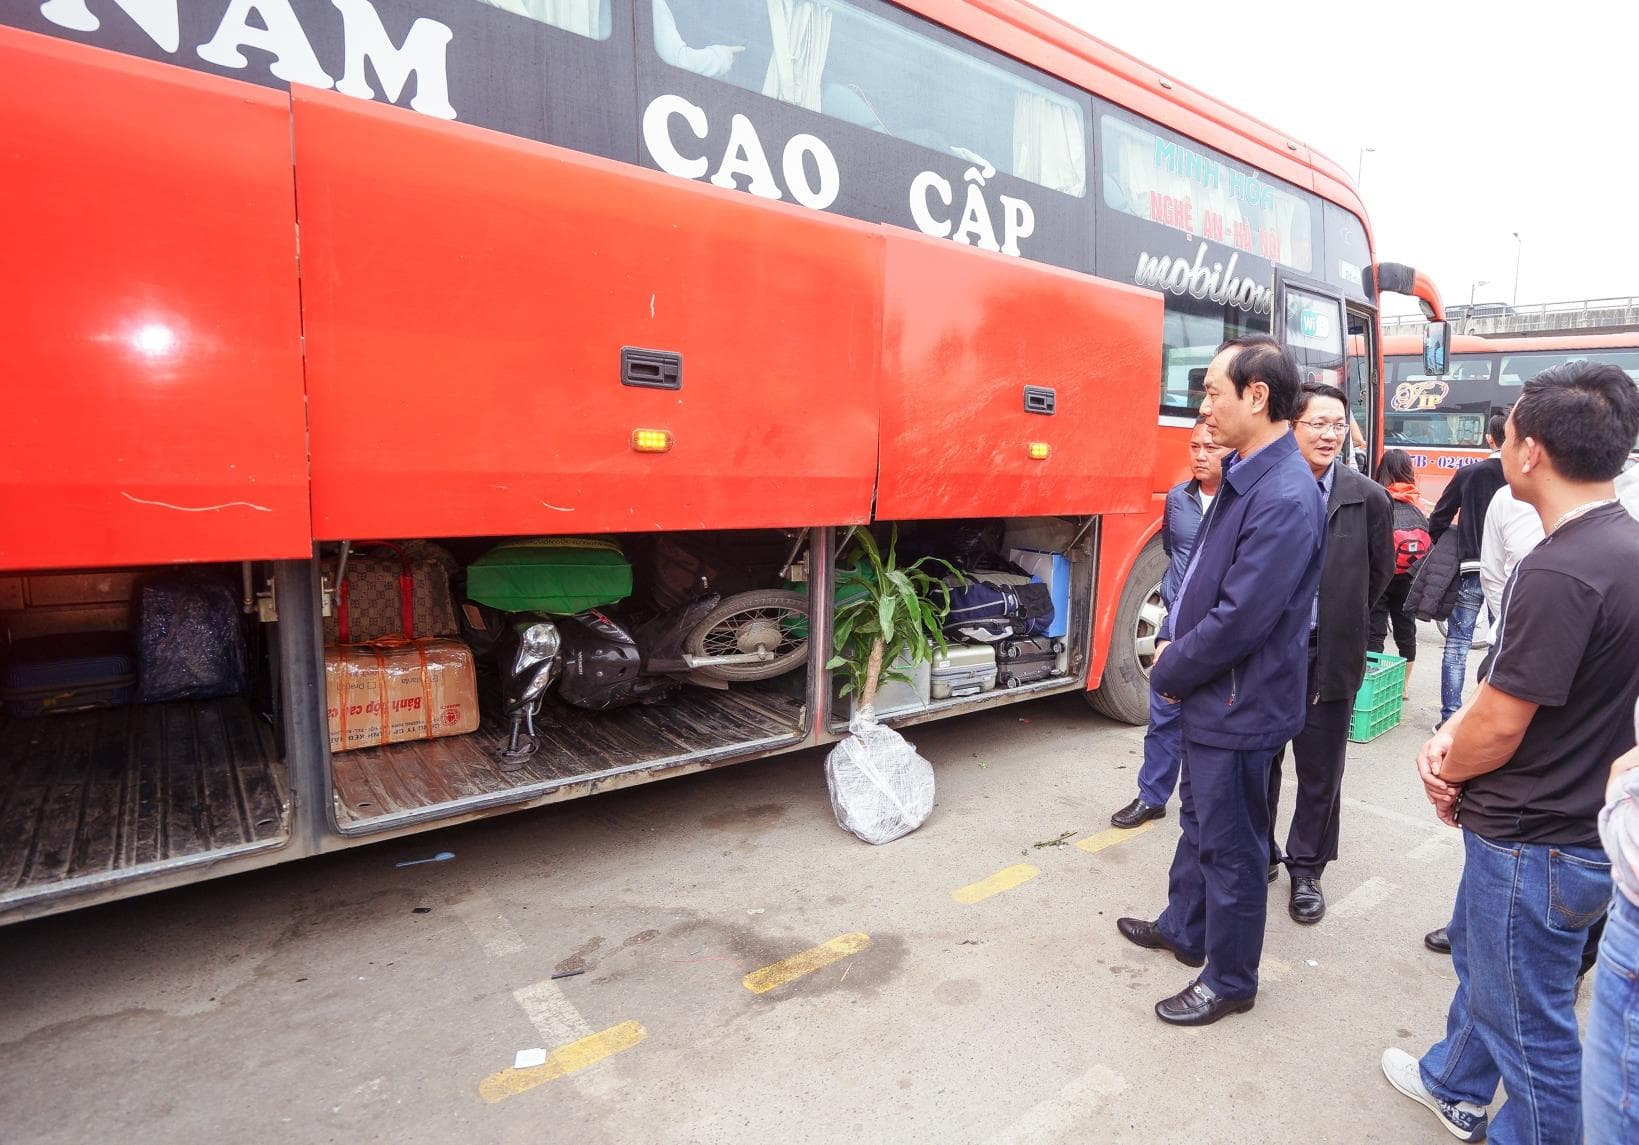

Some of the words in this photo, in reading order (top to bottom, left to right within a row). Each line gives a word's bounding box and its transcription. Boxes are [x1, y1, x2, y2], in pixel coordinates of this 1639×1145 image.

[643, 94, 840, 210] CAO
[1154, 136, 1219, 189] MINH
[1150, 190, 1193, 241] NGHỆ
